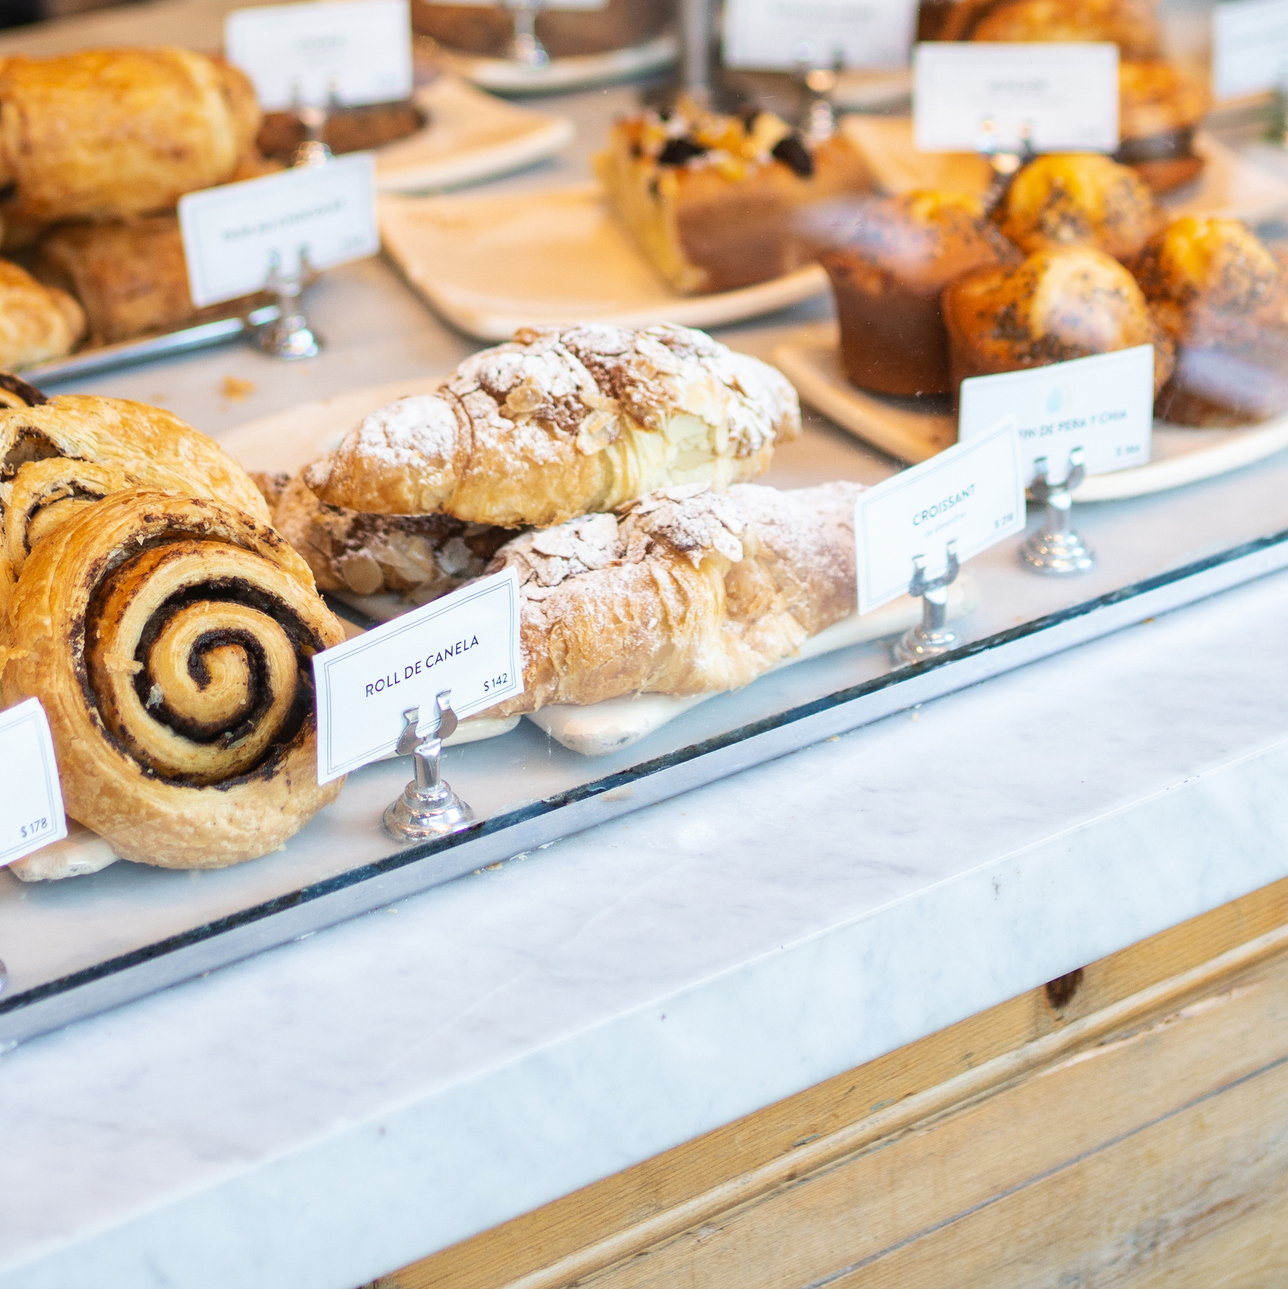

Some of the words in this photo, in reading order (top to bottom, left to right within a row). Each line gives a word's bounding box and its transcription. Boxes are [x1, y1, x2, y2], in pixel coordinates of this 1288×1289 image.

[1039, 423, 1054, 437] DE
[1057, 417, 1087, 431] PERA
[912, 483, 976, 526] CROISSANT
[365, 671, 401, 698] ROLL
[404, 660, 422, 680] DE
[425, 635, 480, 668] CANELA
